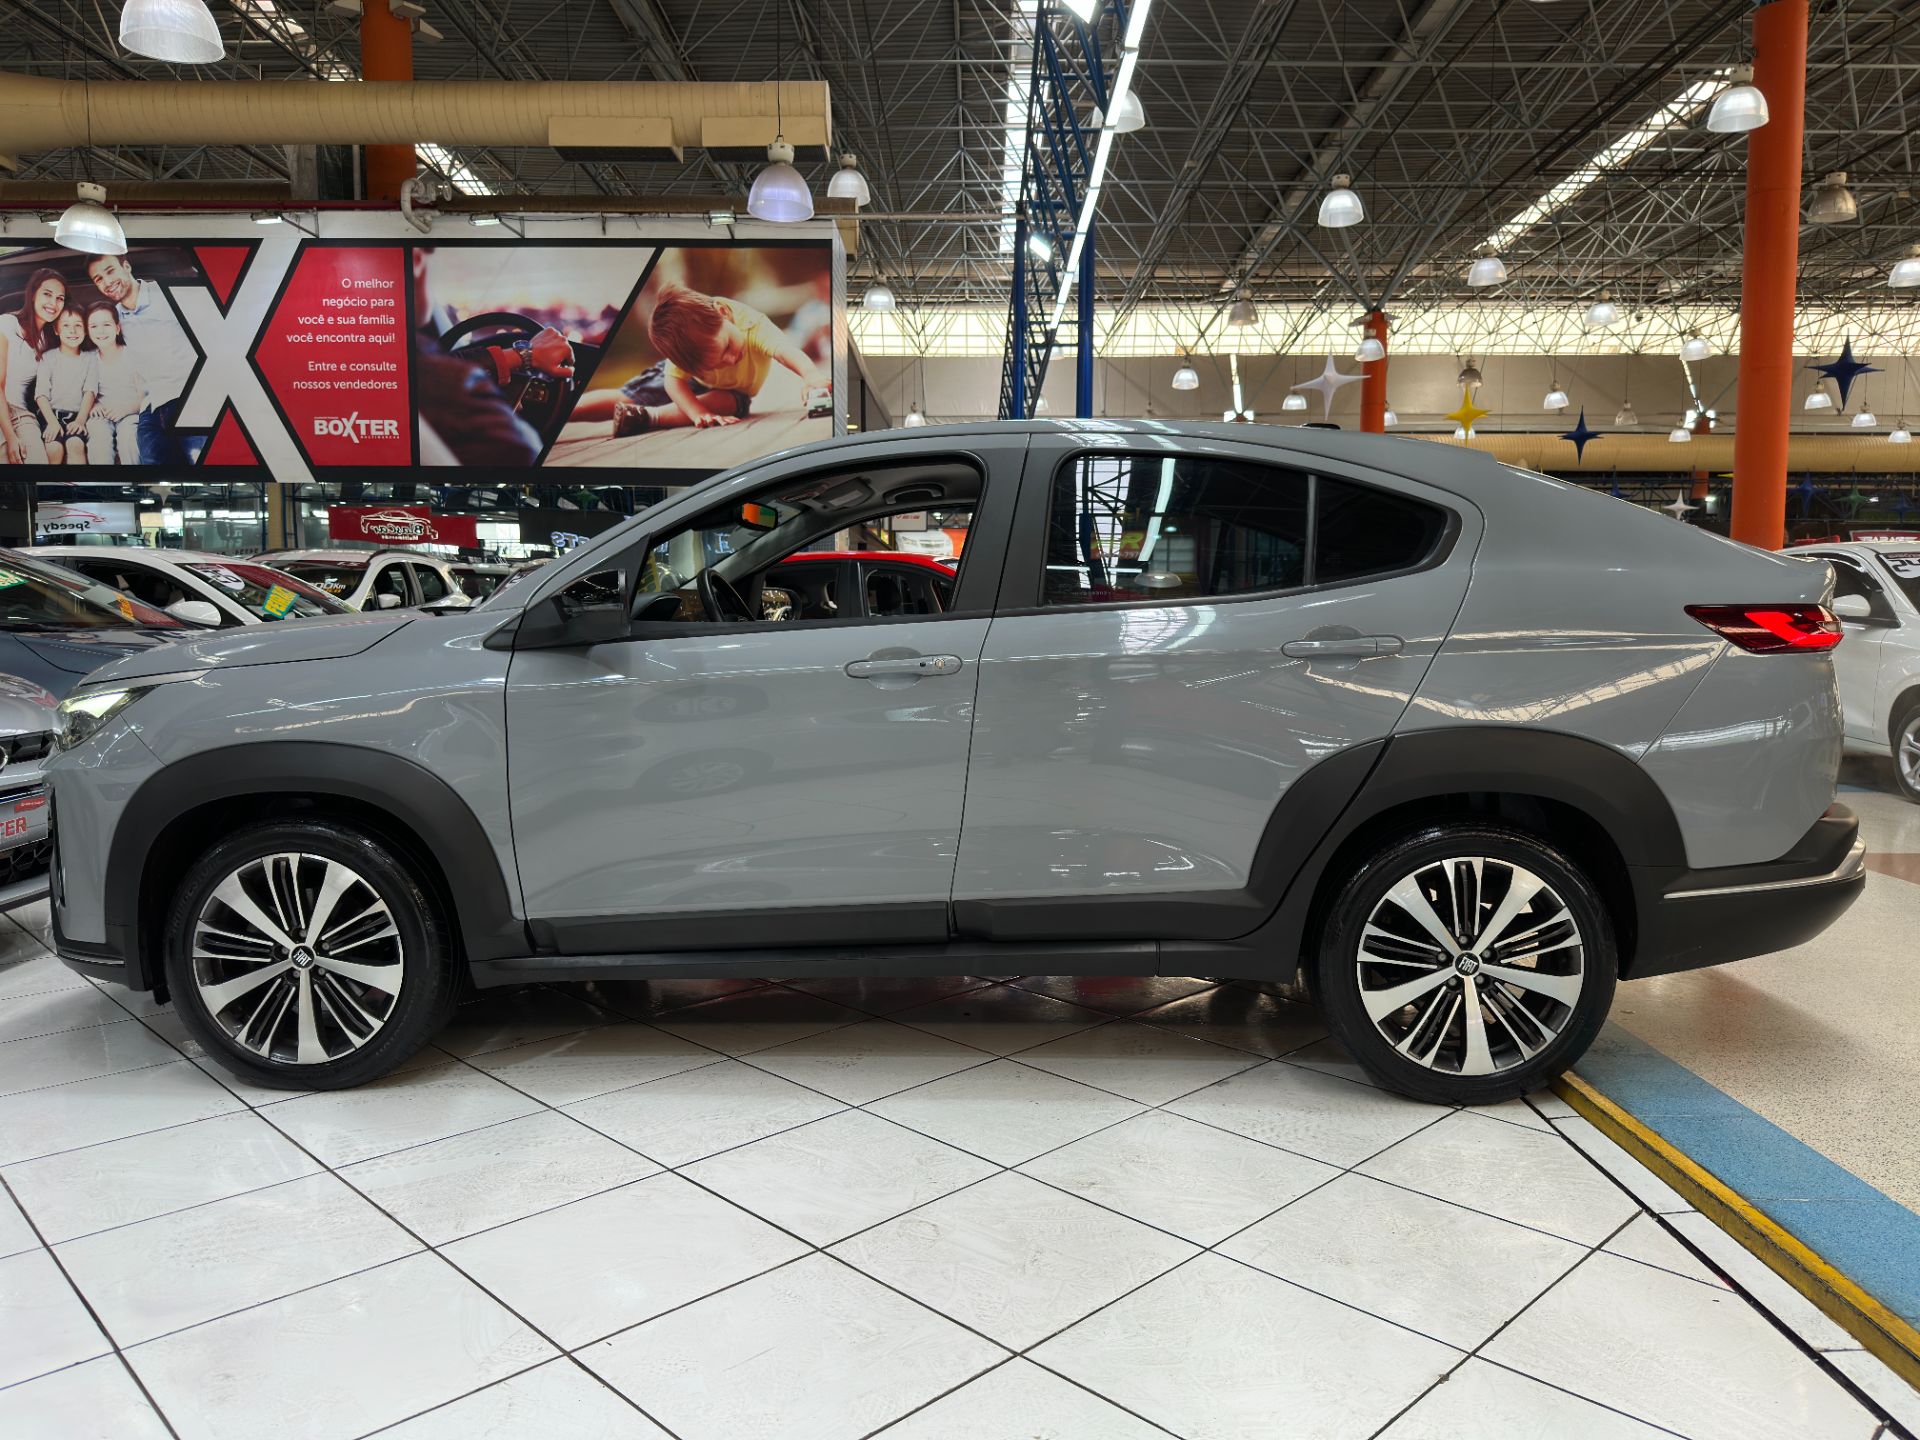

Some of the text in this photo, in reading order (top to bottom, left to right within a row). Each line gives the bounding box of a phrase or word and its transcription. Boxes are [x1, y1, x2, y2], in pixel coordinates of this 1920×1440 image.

[341, 278, 394, 289] O melhor
[322, 296, 395, 309] negócio para
[297, 314, 396, 325] você e sua família
[286, 332, 396, 346] você encontra aqui!
[307, 360, 397, 372] Entre e consulte
[293, 379, 398, 390] nossos vendedores
[313, 411, 400, 444] BOXTER
[292, 947, 313, 967] FIAT
[1458, 956, 1479, 974] FIAT
